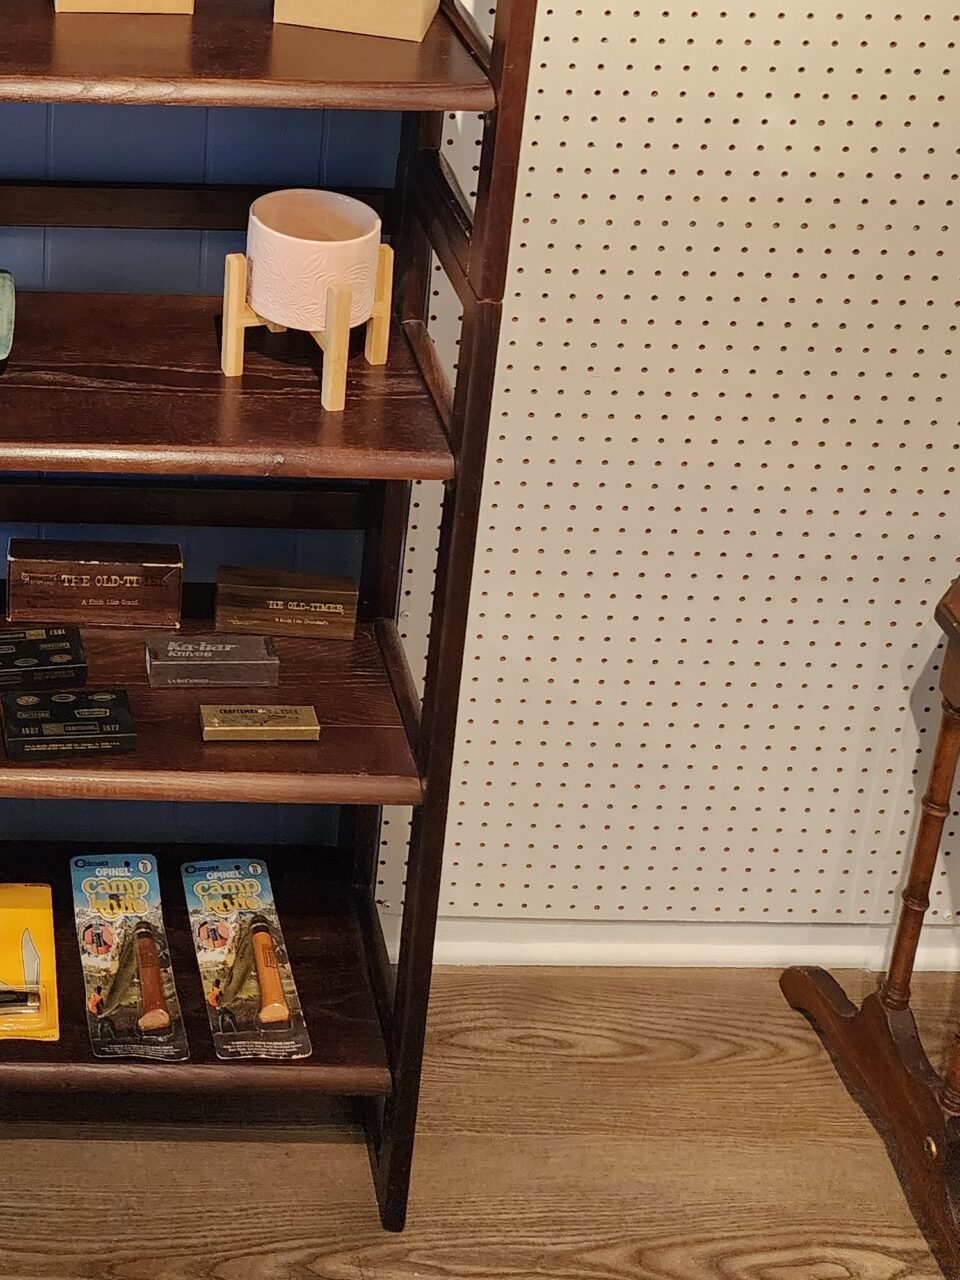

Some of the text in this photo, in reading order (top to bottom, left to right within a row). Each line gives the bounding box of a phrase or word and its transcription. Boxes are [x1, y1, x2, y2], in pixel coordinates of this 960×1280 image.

[61, 574, 90, 587] THE
[167, 641, 233, 651] Ka-bar
[95, 868, 131, 876] OPINEL
[207, 871, 242, 880] OPINEL
[82, 877, 149, 897] camp
[194, 879, 261, 897] camp
[88, 893, 148, 919] knife
[201, 894, 261, 917] knife
